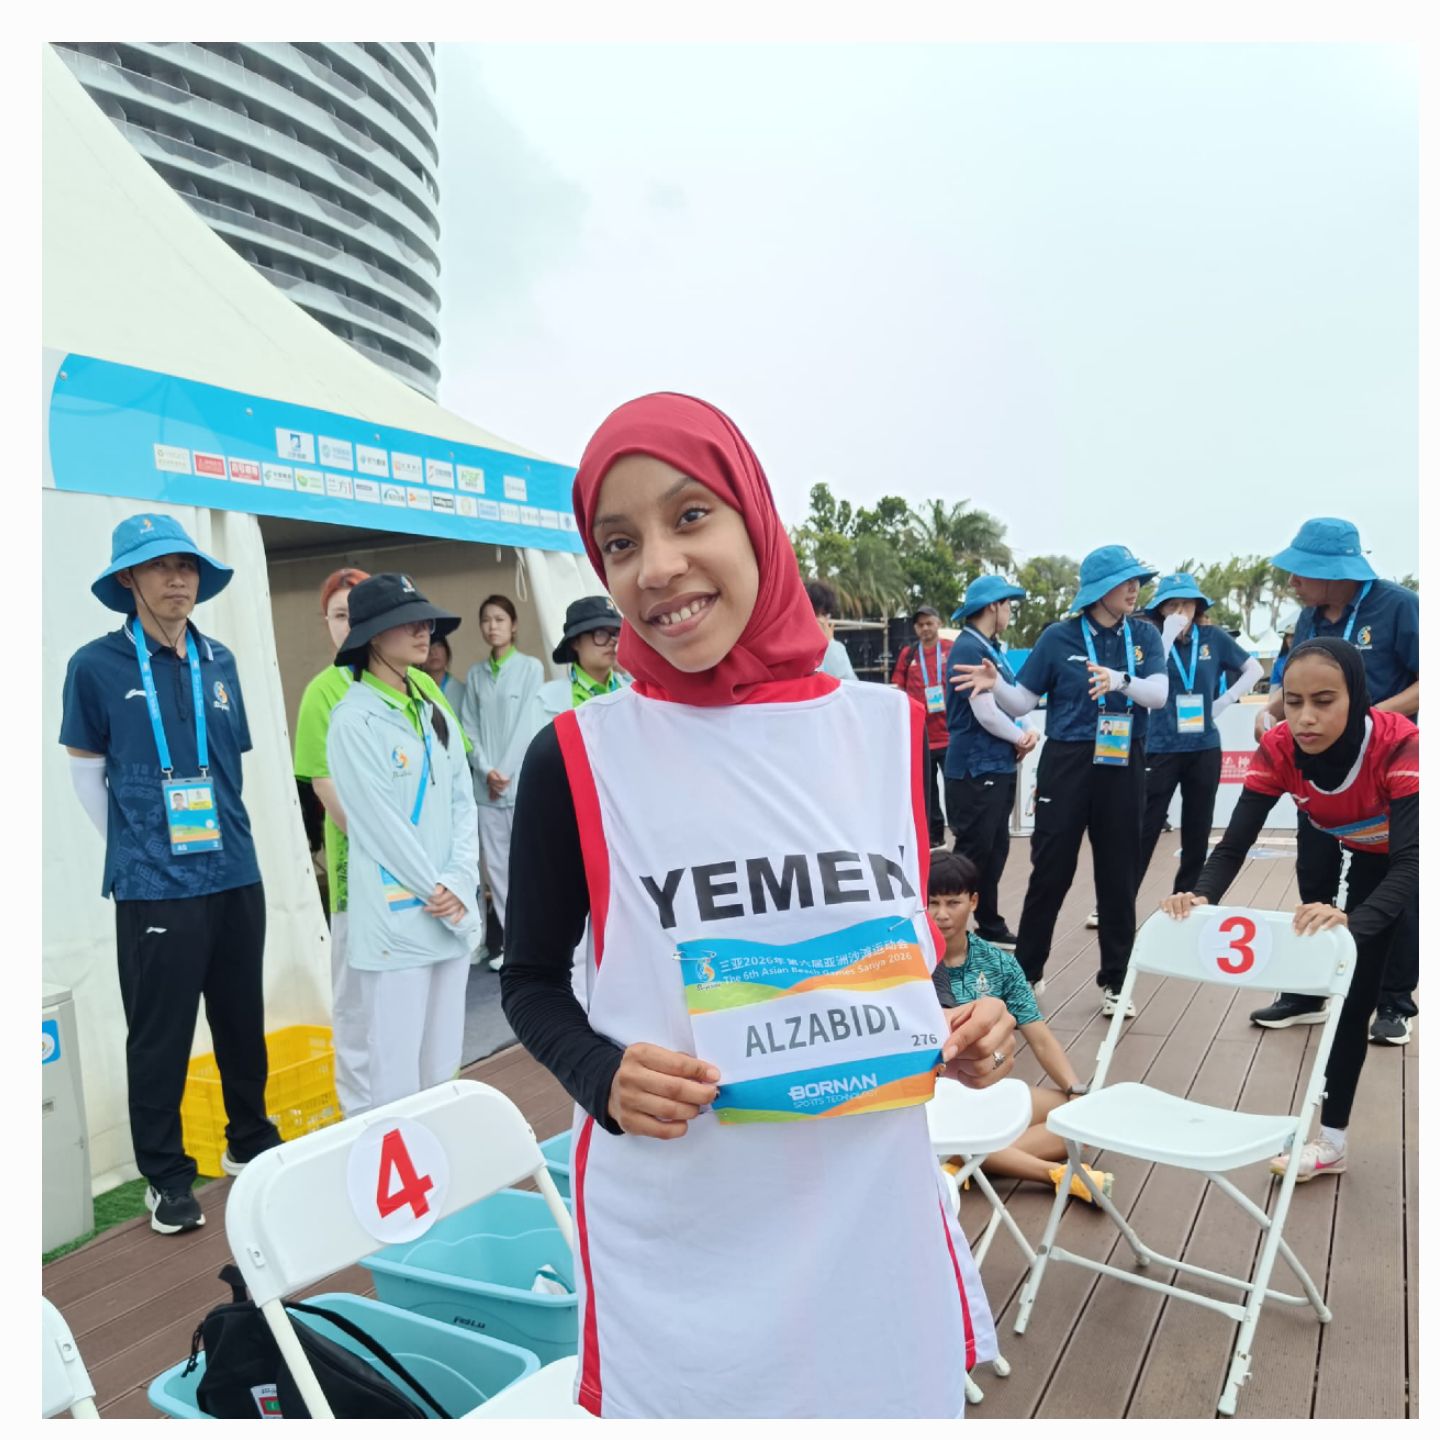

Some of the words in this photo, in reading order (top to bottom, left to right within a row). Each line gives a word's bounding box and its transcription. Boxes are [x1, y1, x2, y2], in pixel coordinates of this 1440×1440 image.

[639, 846, 917, 930] YEMEN
[743, 969, 759, 980] 6th
[761, 966, 789, 977] Asian
[858, 958, 886, 973] Sanya
[888, 951, 913, 963] 2026
[1216, 916, 1256, 974] 3
[744, 1004, 901, 1058] ALZABIDI
[911, 1031, 938, 1048] 276
[787, 1072, 878, 1101] BORNAN
[376, 1128, 435, 1220] 4
